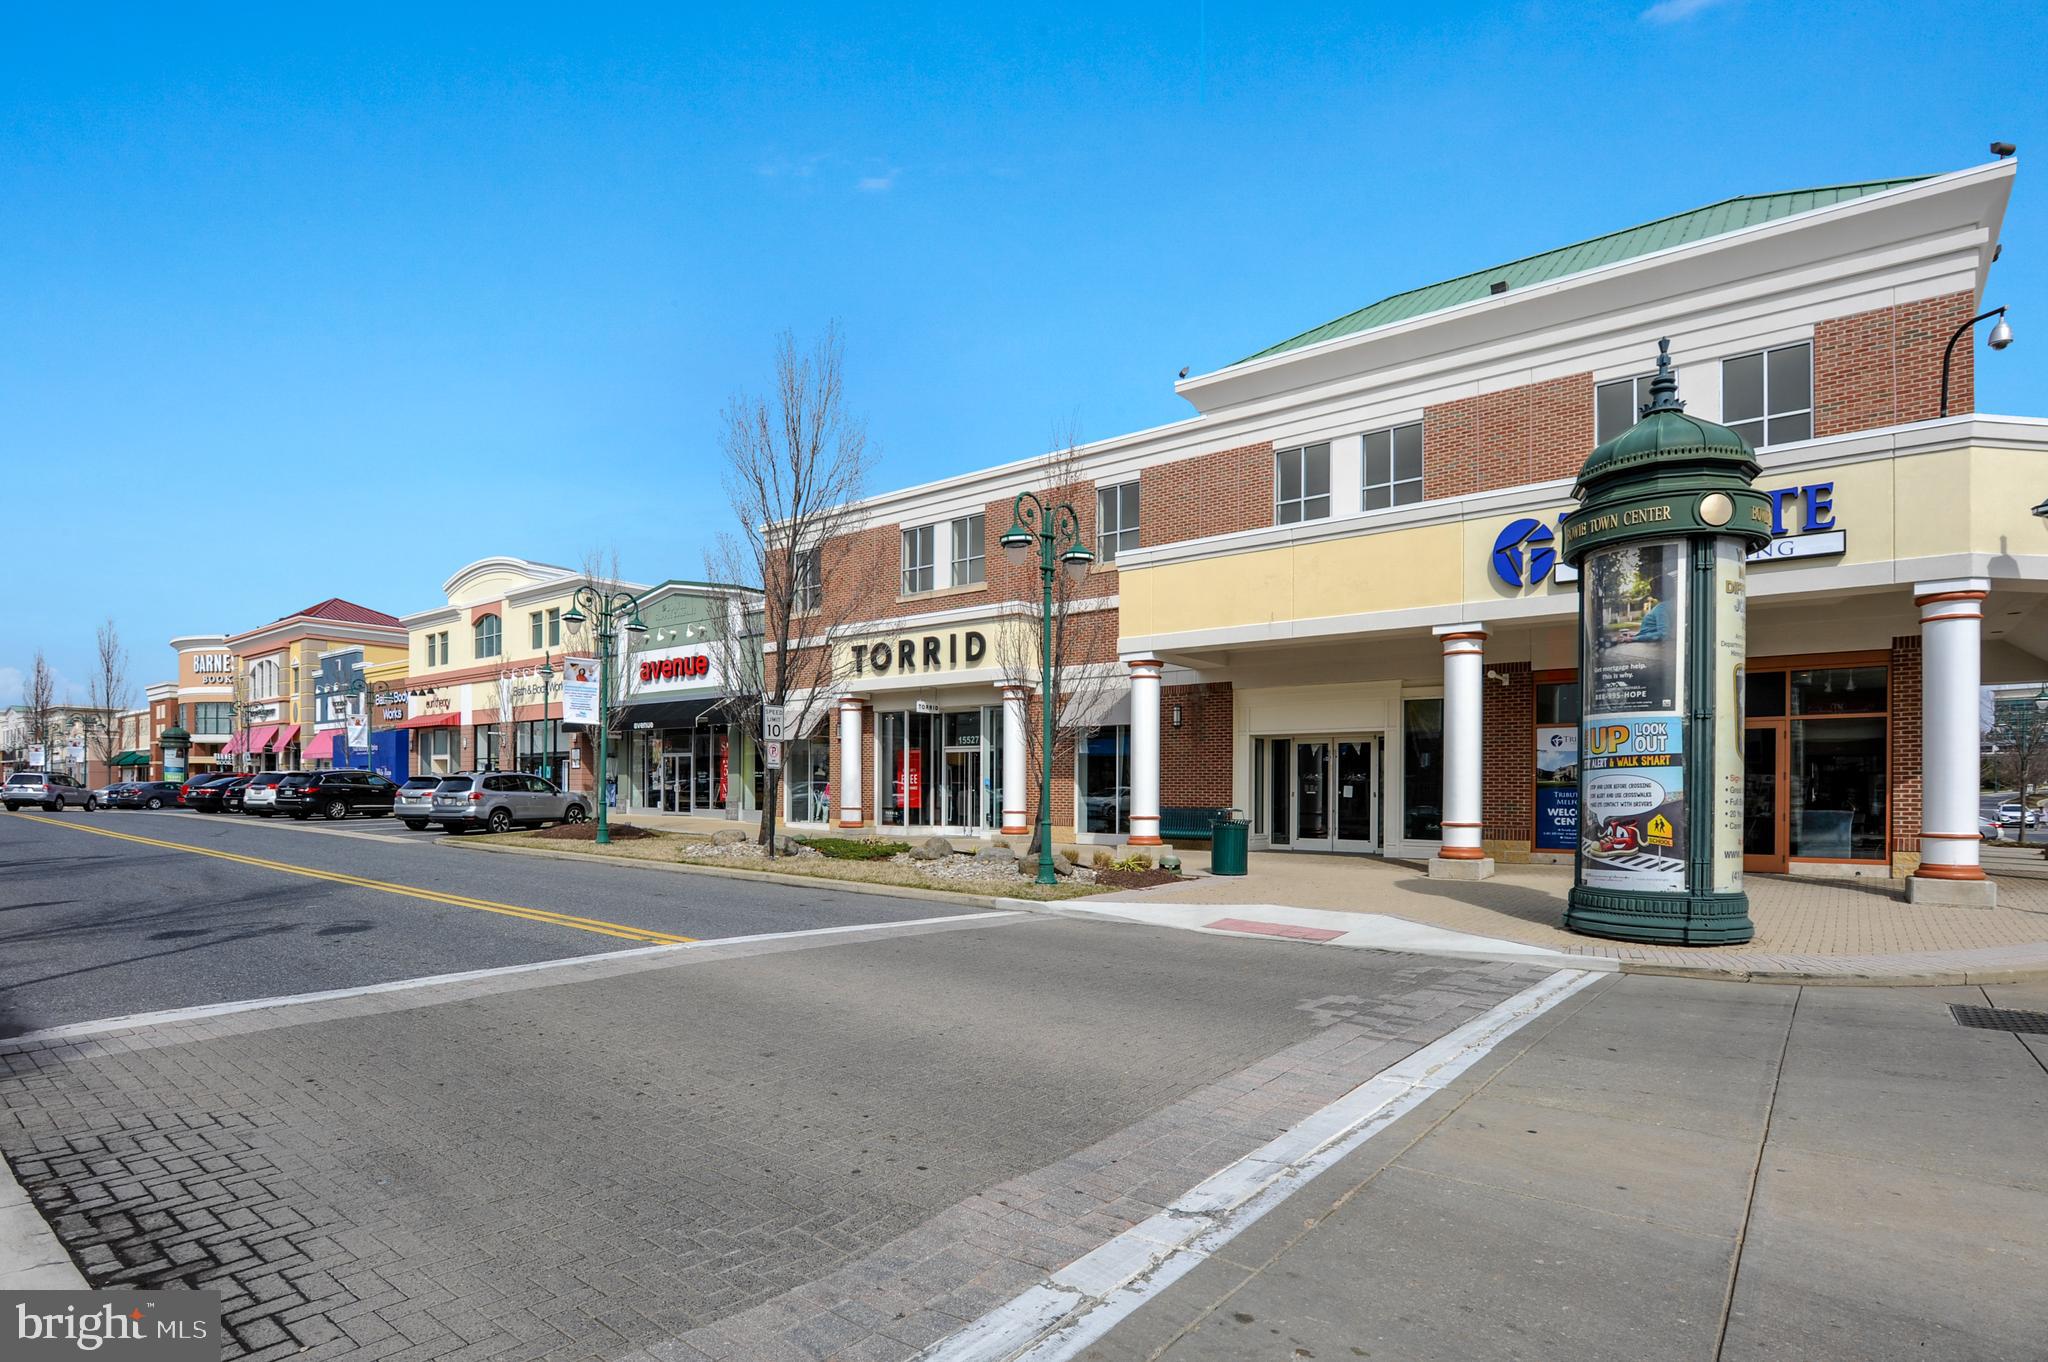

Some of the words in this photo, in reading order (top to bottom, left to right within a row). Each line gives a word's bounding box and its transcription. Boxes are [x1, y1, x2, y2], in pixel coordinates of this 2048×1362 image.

[1590, 513, 1618, 533] TOWN
[1623, 505, 1672, 526] CENTER
[851, 631, 987, 673] TORRID
[640, 655, 709, 682] avenue
[1602, 664, 1629, 674] mortgage
[1630, 662, 1647, 671] help.
[767, 724, 781, 737] 10
[959, 736, 979, 744] 15527
[1591, 725, 1630, 755] UP
[1634, 723, 1667, 736] LOOK
[1634, 735, 1668, 752] OUT
[1591, 757, 1607, 769] ALERT
[1609, 757, 1614, 768] &
[1616, 756, 1639, 768] WALK
[1641, 754, 1671, 766] SMART
[1547, 808, 1578, 816] WELC
[1648, 837, 1671, 845] SCHOOL
